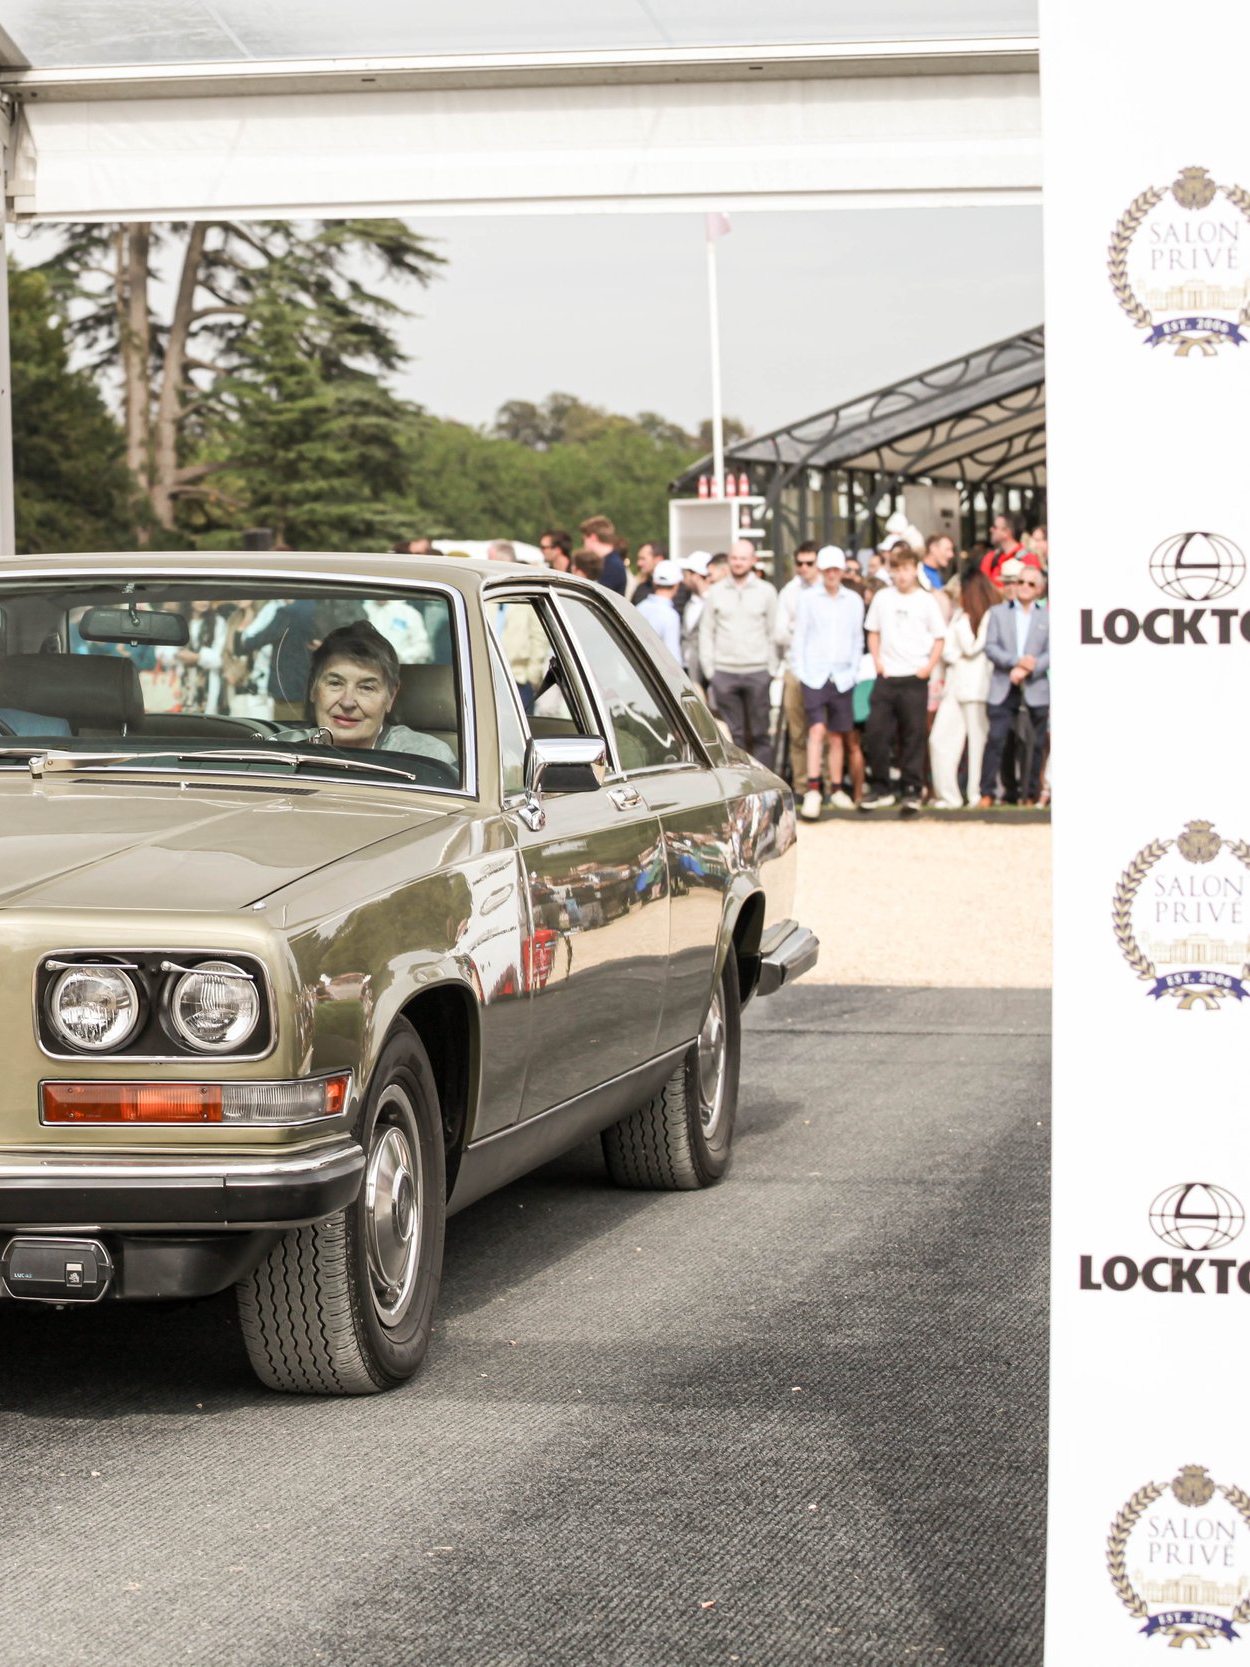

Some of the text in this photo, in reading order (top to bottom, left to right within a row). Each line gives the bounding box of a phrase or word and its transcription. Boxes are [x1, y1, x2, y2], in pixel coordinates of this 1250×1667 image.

[1150, 221, 1239, 244] SALON
[1162, 318, 1191, 334] EST.
[1080, 608, 1250, 645] LOCKT
[1155, 875, 1243, 898] SALON
[1166, 972, 1195, 987] EST.
[1149, 1515, 1236, 1541] SALON
[1158, 1611, 1186, 1626] EST.
